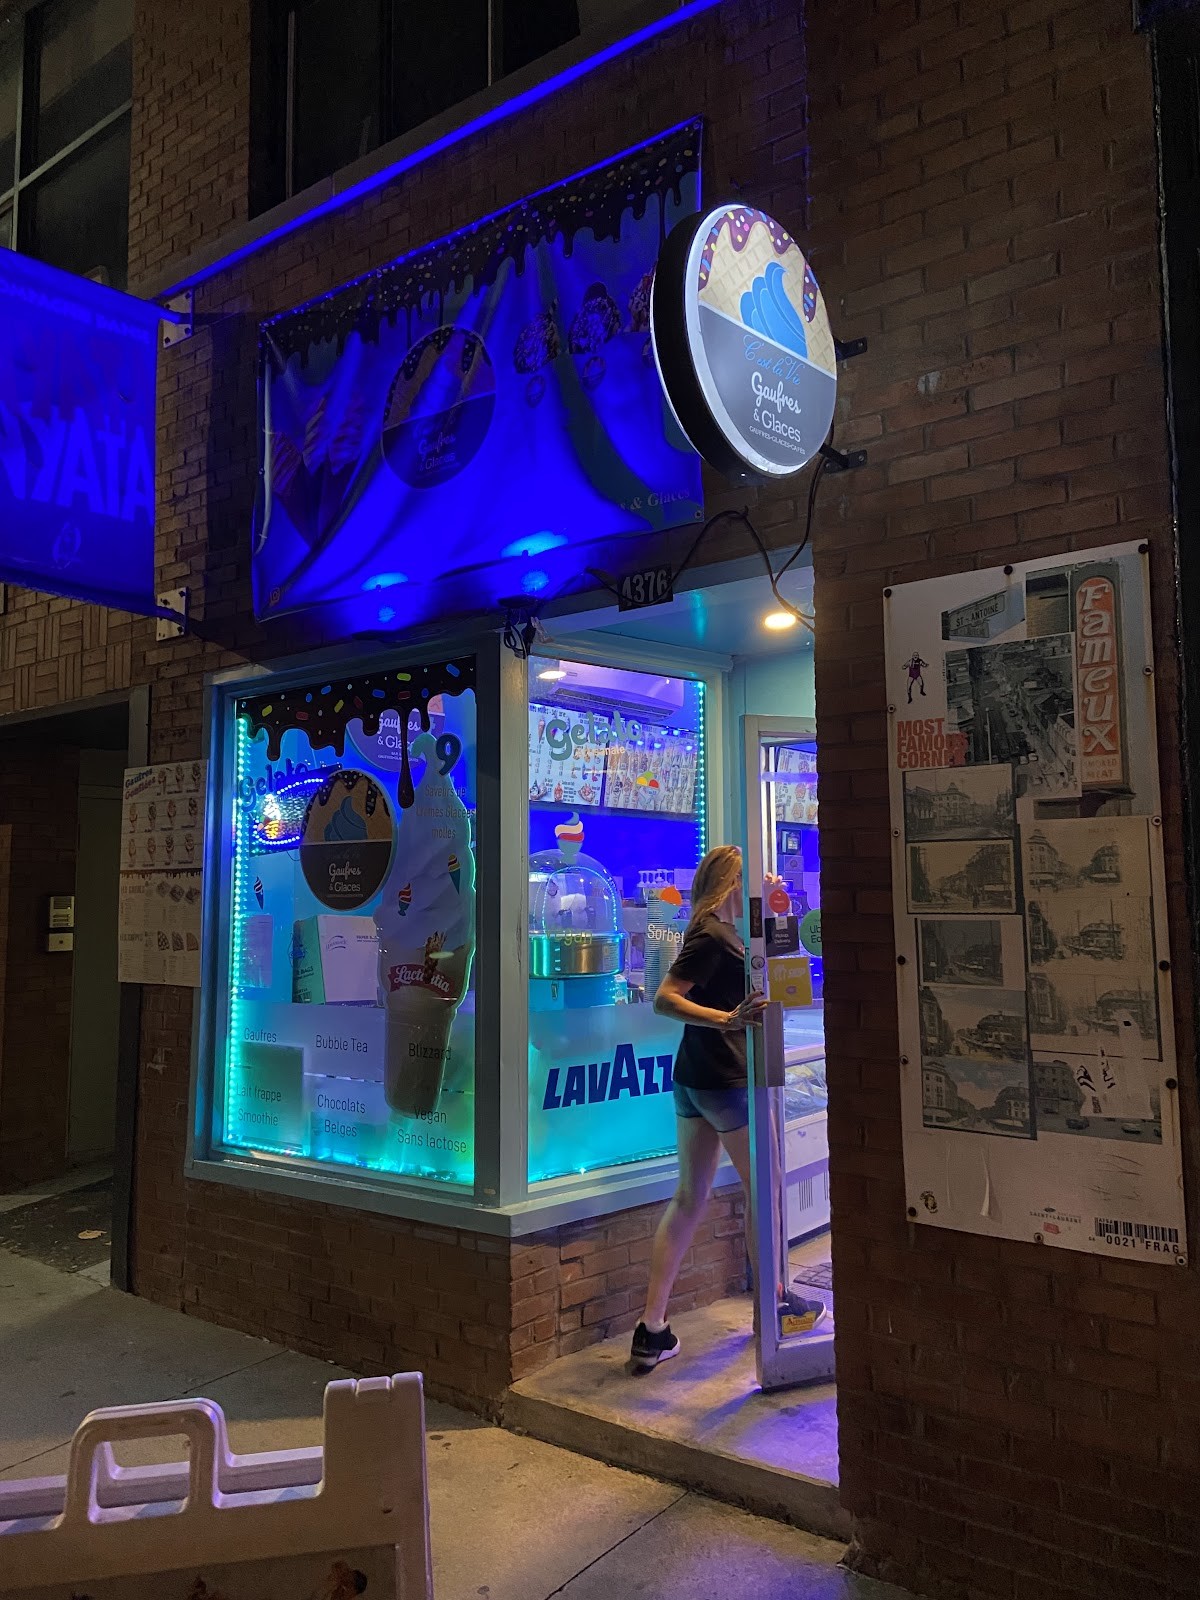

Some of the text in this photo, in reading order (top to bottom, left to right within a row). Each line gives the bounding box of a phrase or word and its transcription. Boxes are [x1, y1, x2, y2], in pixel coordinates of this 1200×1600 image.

[751, 371, 802, 414] Gaufres
[753, 408, 801, 442] & Glaces
[630, 496, 643, 510] &
[621, 569, 669, 607] 4376
[545, 710, 642, 762] gelato
[897, 718, 945, 740] MOST
[436, 733, 462, 776] 9
[425, 783, 466, 798] Saveurs de
[431, 826, 457, 840] molles
[328, 861, 362, 883] Gaufres
[329, 881, 361, 893] & Glaces
[244, 1027, 277, 1043] Gaufres
[315, 1034, 368, 1053] Bubble Tea
[408, 1042, 451, 1060] Blizzard
[542, 1043, 674, 1110] LAVAZZ
[317, 1094, 366, 1114] Chocolats
[237, 1108, 279, 1127] Smoothie
[414, 1105, 447, 1125] Vegan
[324, 1119, 357, 1138] Belges
[397, 1128, 467, 1154] Sans lactose
[1106, 1234, 1136, 1249] 0021
[1145, 1240, 1180, 1255] FRAG
